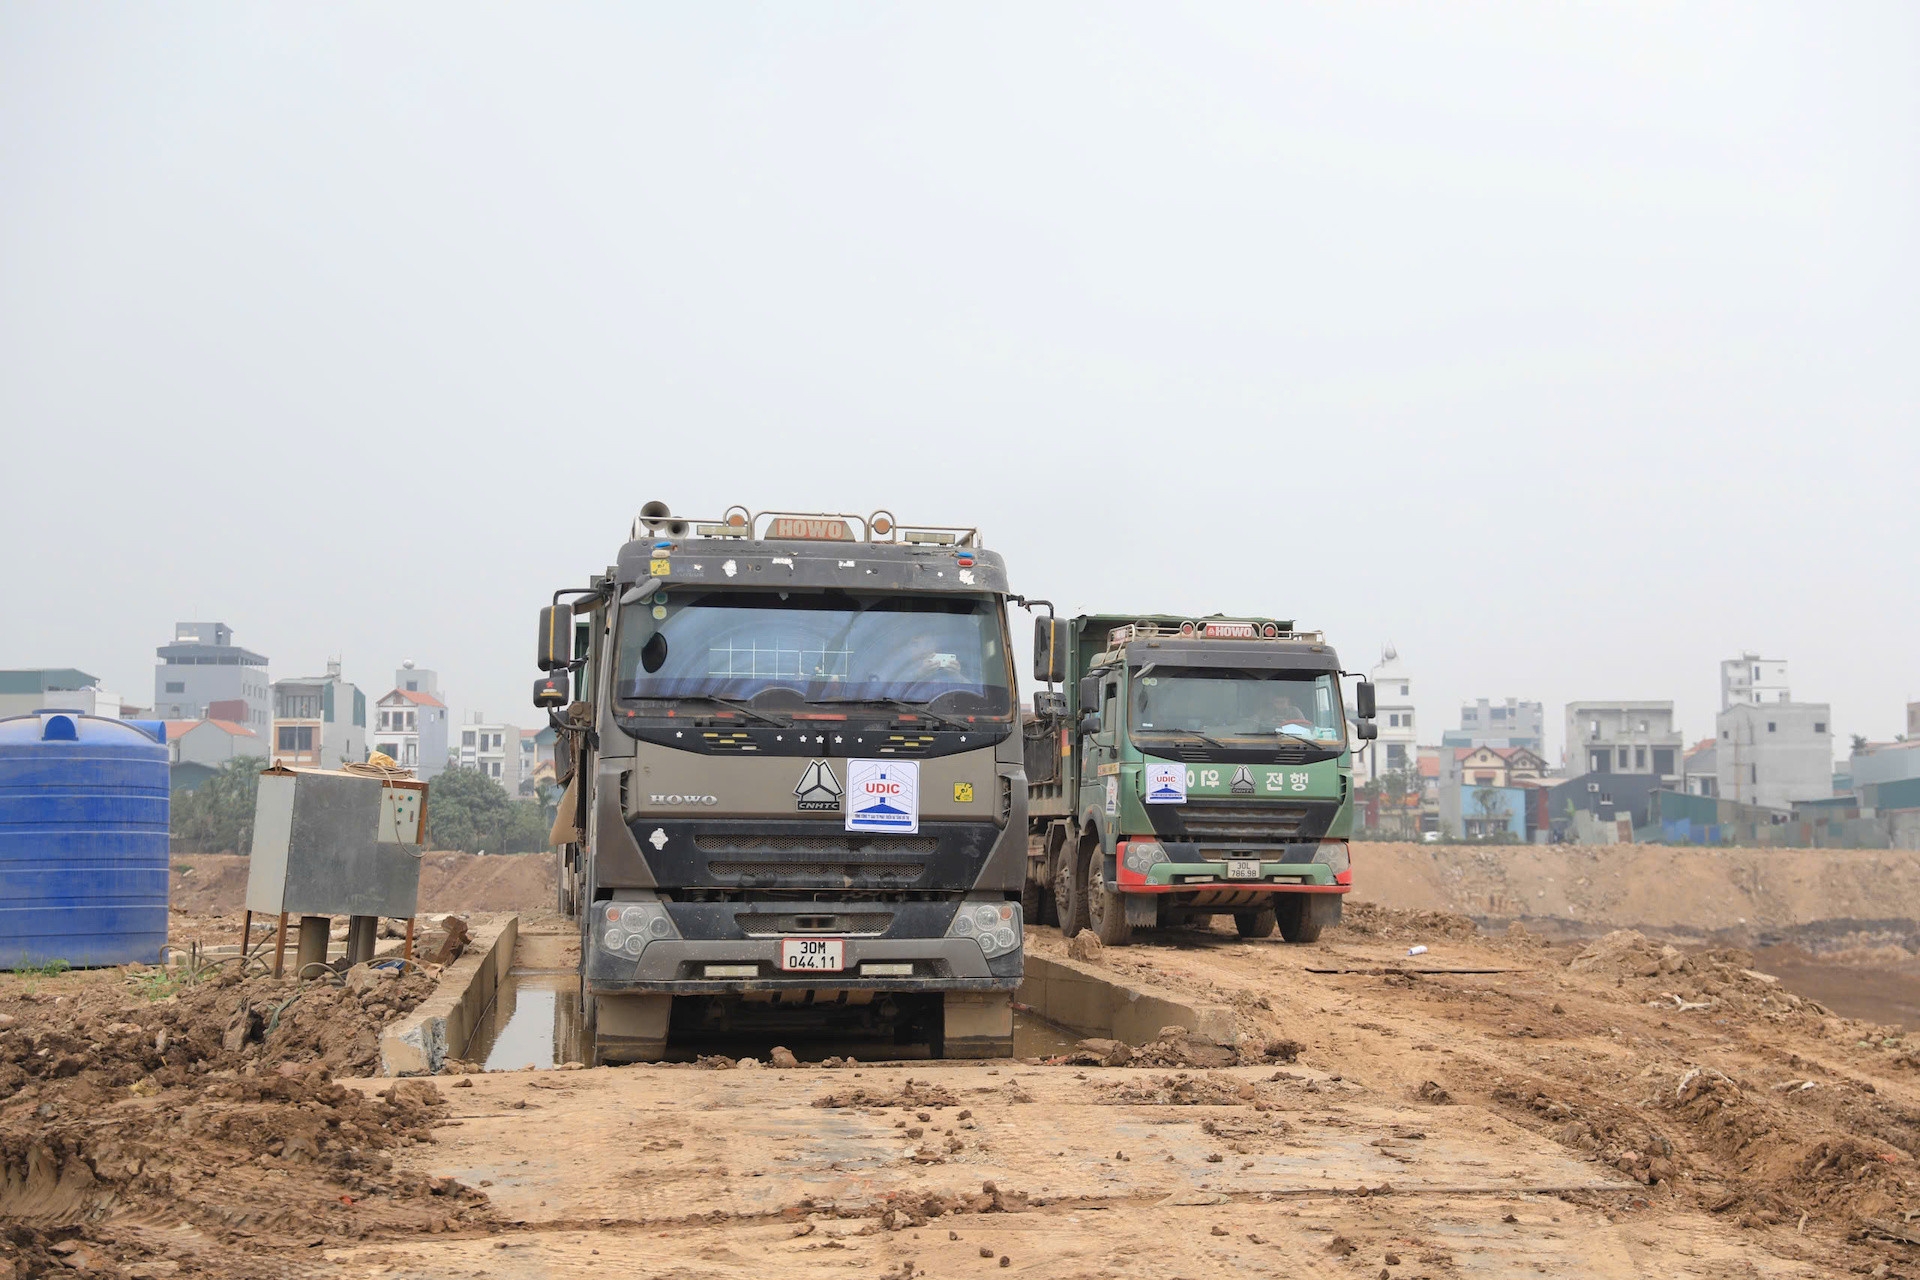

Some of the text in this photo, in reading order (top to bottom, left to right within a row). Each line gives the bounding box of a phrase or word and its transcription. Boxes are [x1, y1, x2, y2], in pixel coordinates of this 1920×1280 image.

[778, 519, 842, 539] HOWO
[1215, 626, 1252, 637] HOWO
[865, 783, 900, 794] UDIC
[649, 794, 718, 806] HOWO
[798, 801, 839, 810] CNHTC
[1237, 862, 1251, 870] 30L
[800, 941, 826, 954] 30M
[789, 955, 835, 969] 044.11
